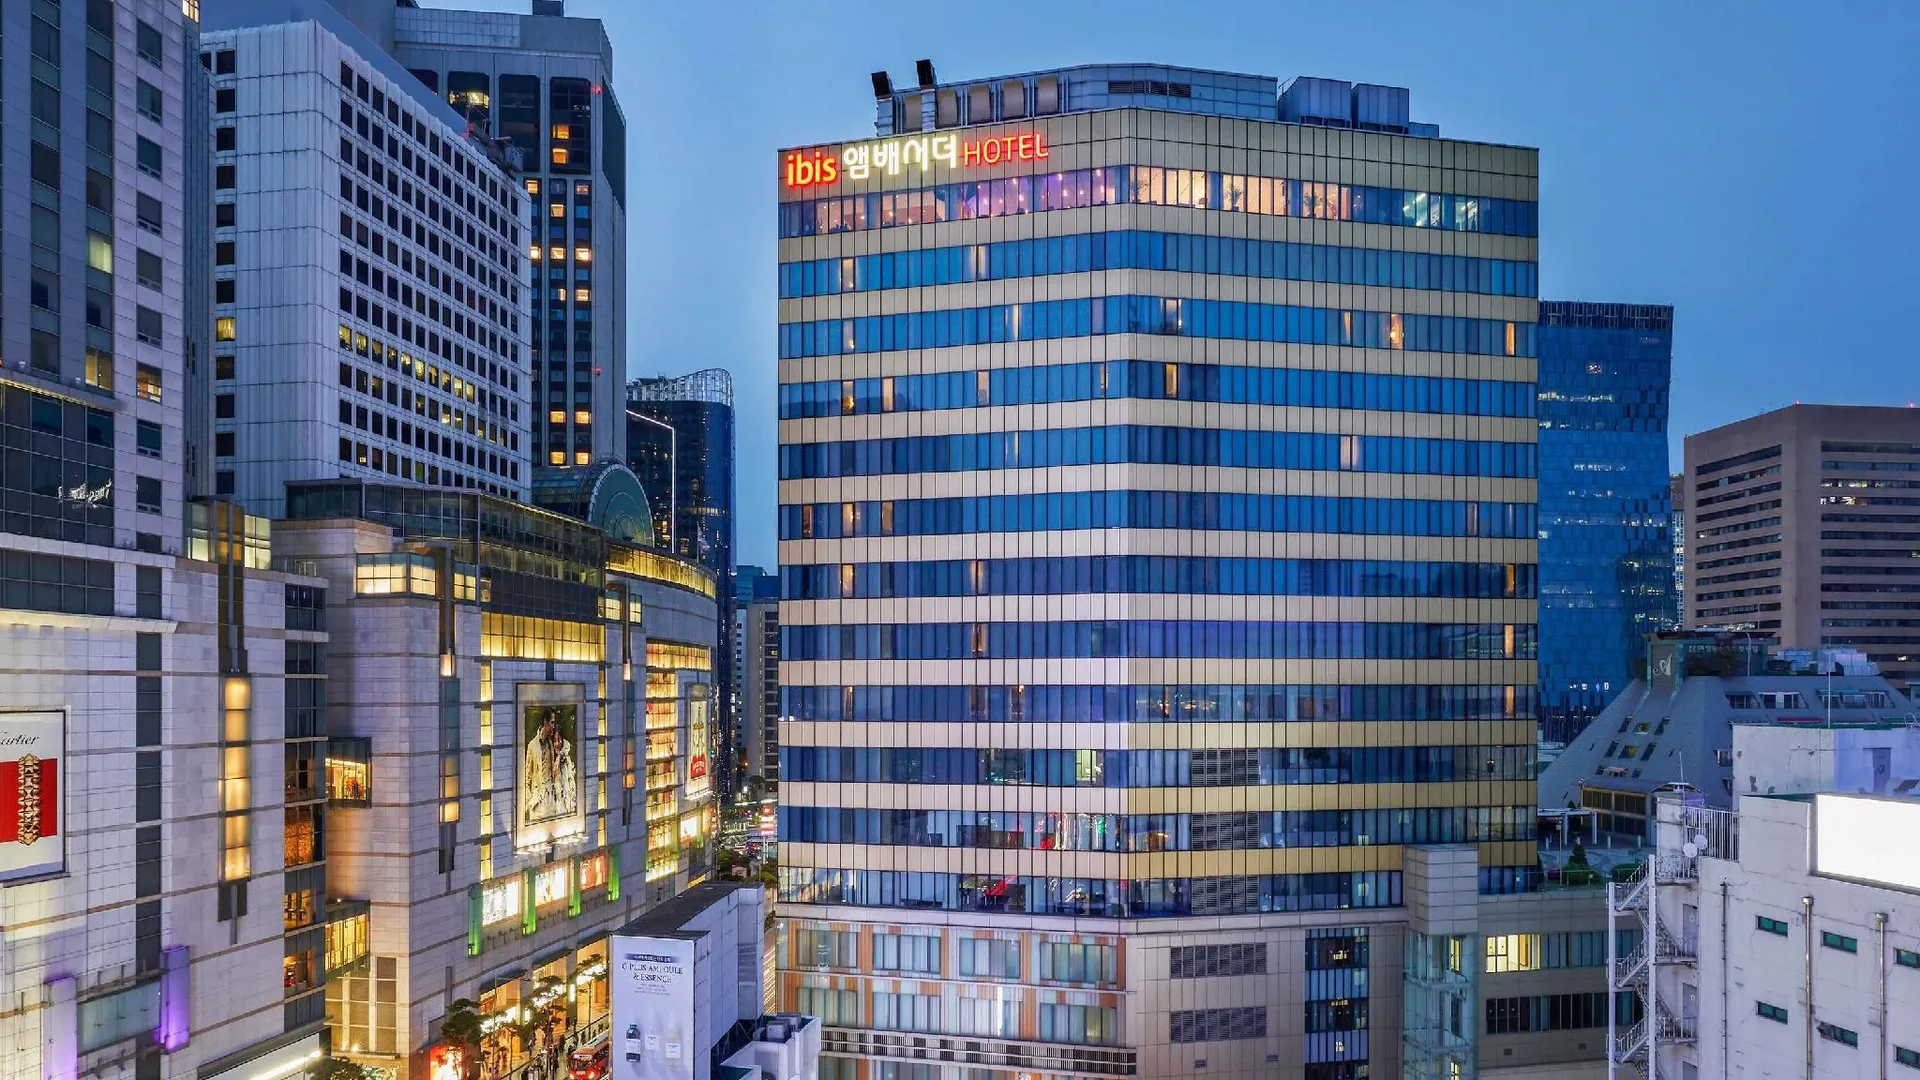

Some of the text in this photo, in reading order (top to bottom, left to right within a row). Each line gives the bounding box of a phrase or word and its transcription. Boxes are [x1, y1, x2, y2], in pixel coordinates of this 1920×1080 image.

[786, 133, 1049, 187] ibis 앰배서더 HOTEL
